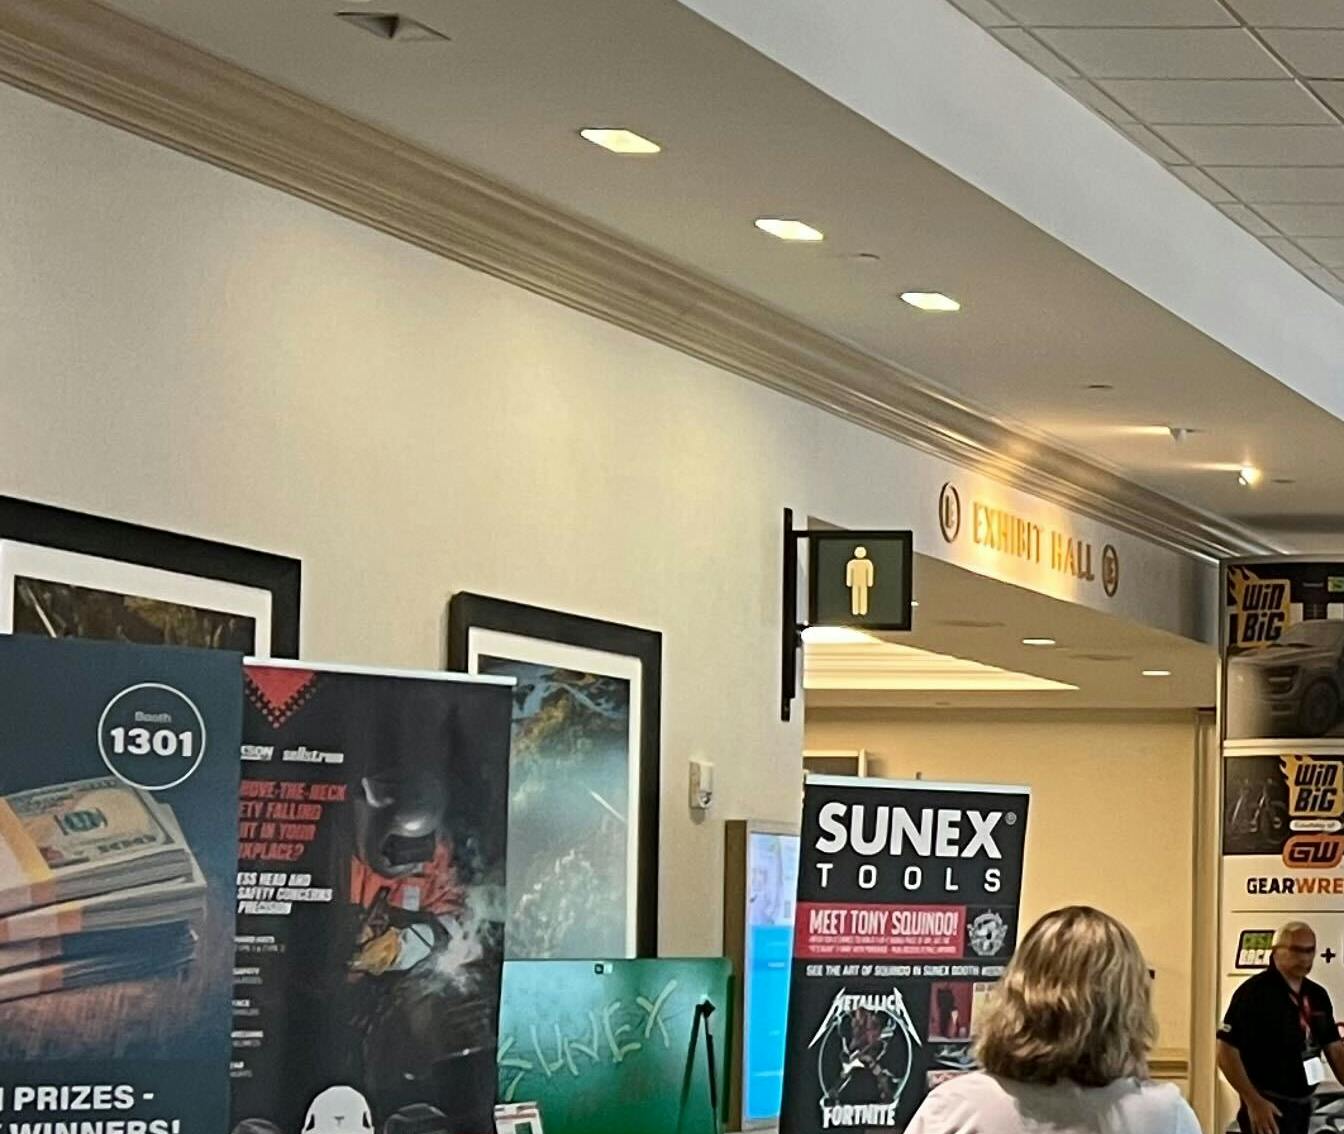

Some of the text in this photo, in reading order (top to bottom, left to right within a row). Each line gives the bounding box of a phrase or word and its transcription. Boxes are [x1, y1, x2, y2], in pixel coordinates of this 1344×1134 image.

[973, 502, 1095, 581] EXHIBIT HALL
[110, 727, 192, 757] 1301
[815, 801, 1003, 859] SUNEX
[258, 873, 287, 886] HEAD
[816, 862, 1001, 892] TOOLS
[237, 887, 275, 900] SAFETY
[809, 909, 959, 937] MEET TONY SQUINDO!
[806, 965, 823, 976] SEE
[825, 965, 841, 976] THE
[842, 965, 859, 976] ART
[861, 965, 873, 976] OF
[923, 965, 949, 976] SUNEX
[496, 979, 678, 1101] SUNEX
[14, 1084, 135, 1112] PRIZES
[821, 1101, 898, 1129] FORTNITE
